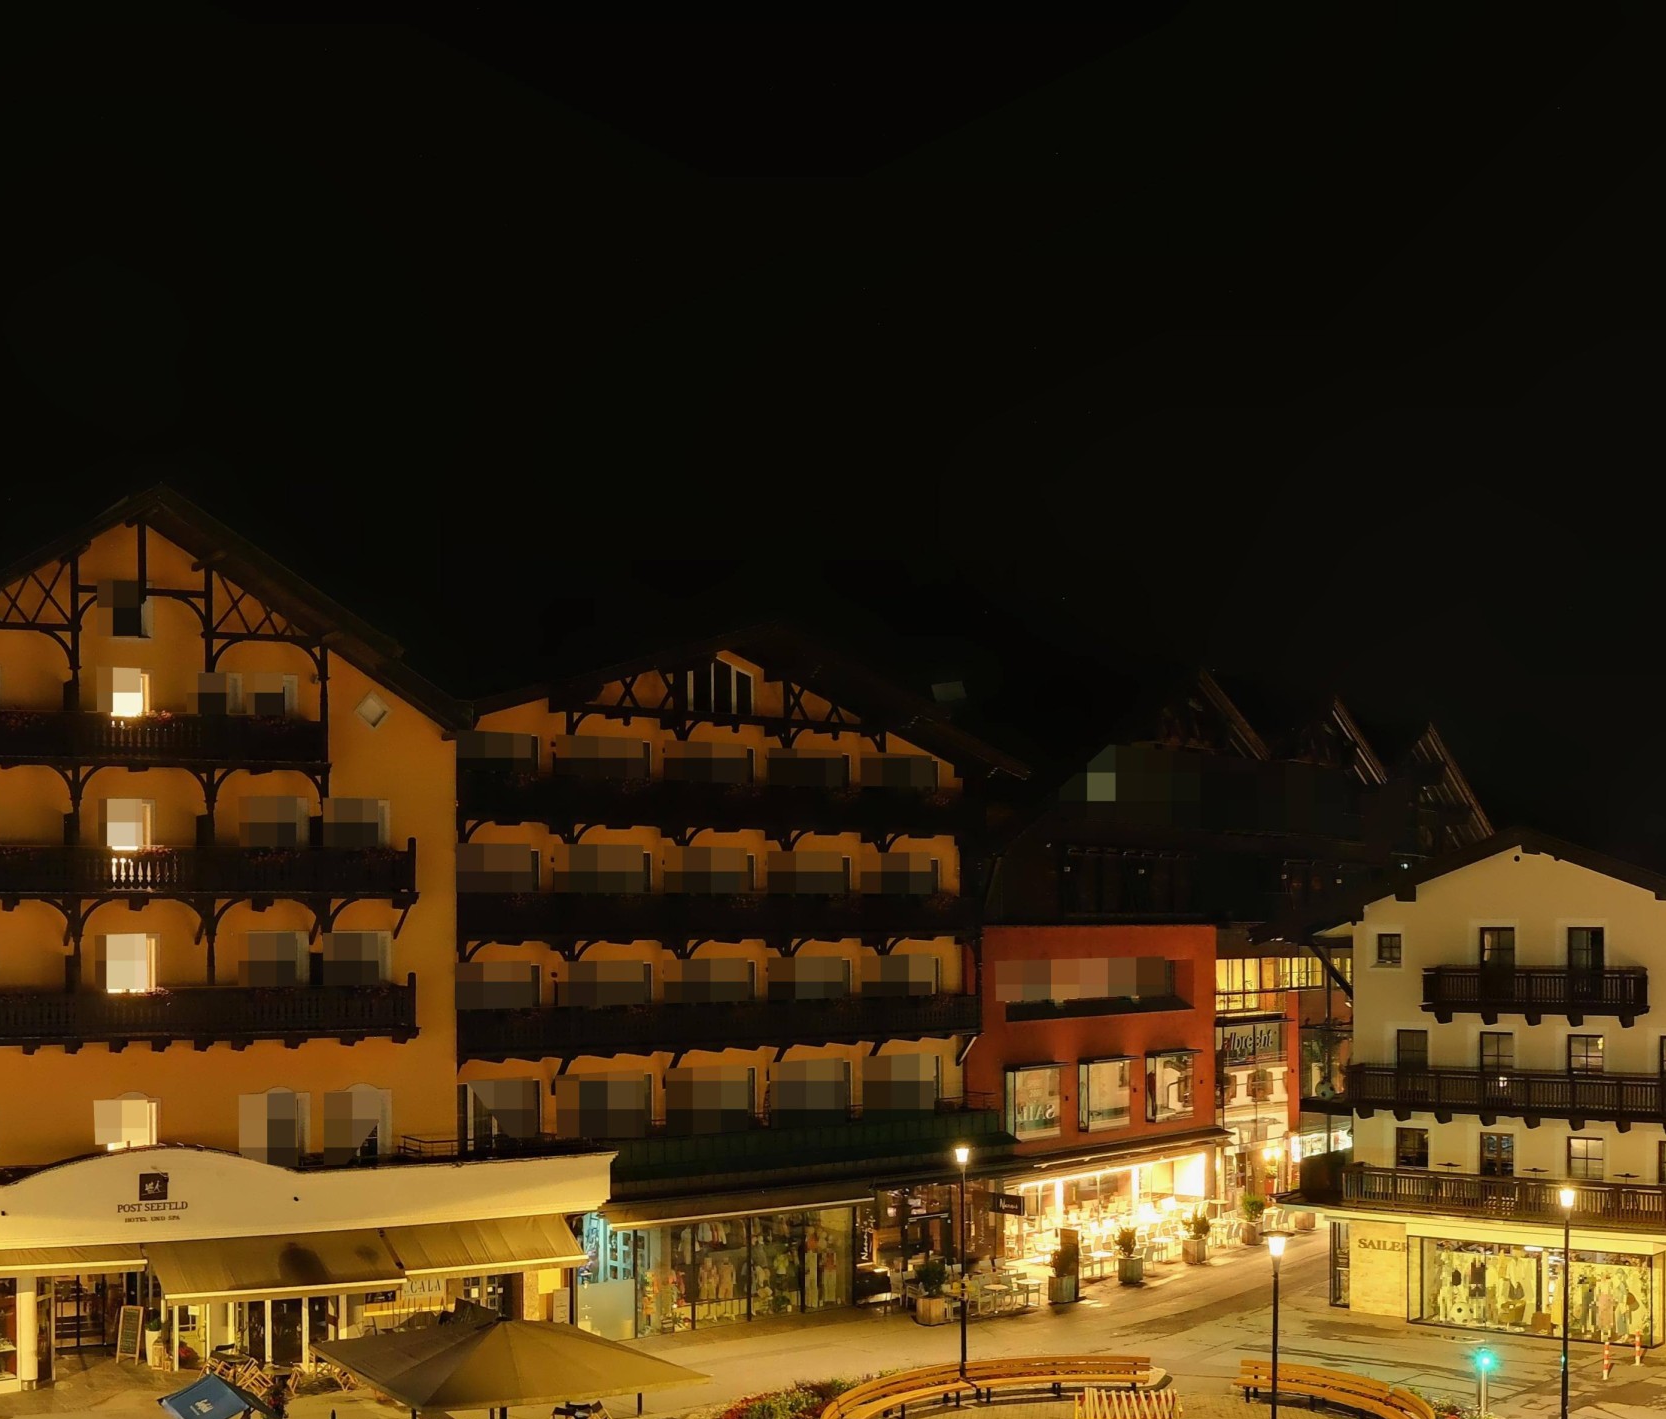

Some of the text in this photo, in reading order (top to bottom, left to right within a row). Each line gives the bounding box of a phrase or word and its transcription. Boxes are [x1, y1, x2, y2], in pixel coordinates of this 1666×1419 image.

[117, 1201, 189, 1213] POST SEEFELD
[404, 1278, 441, 1294] CALA
